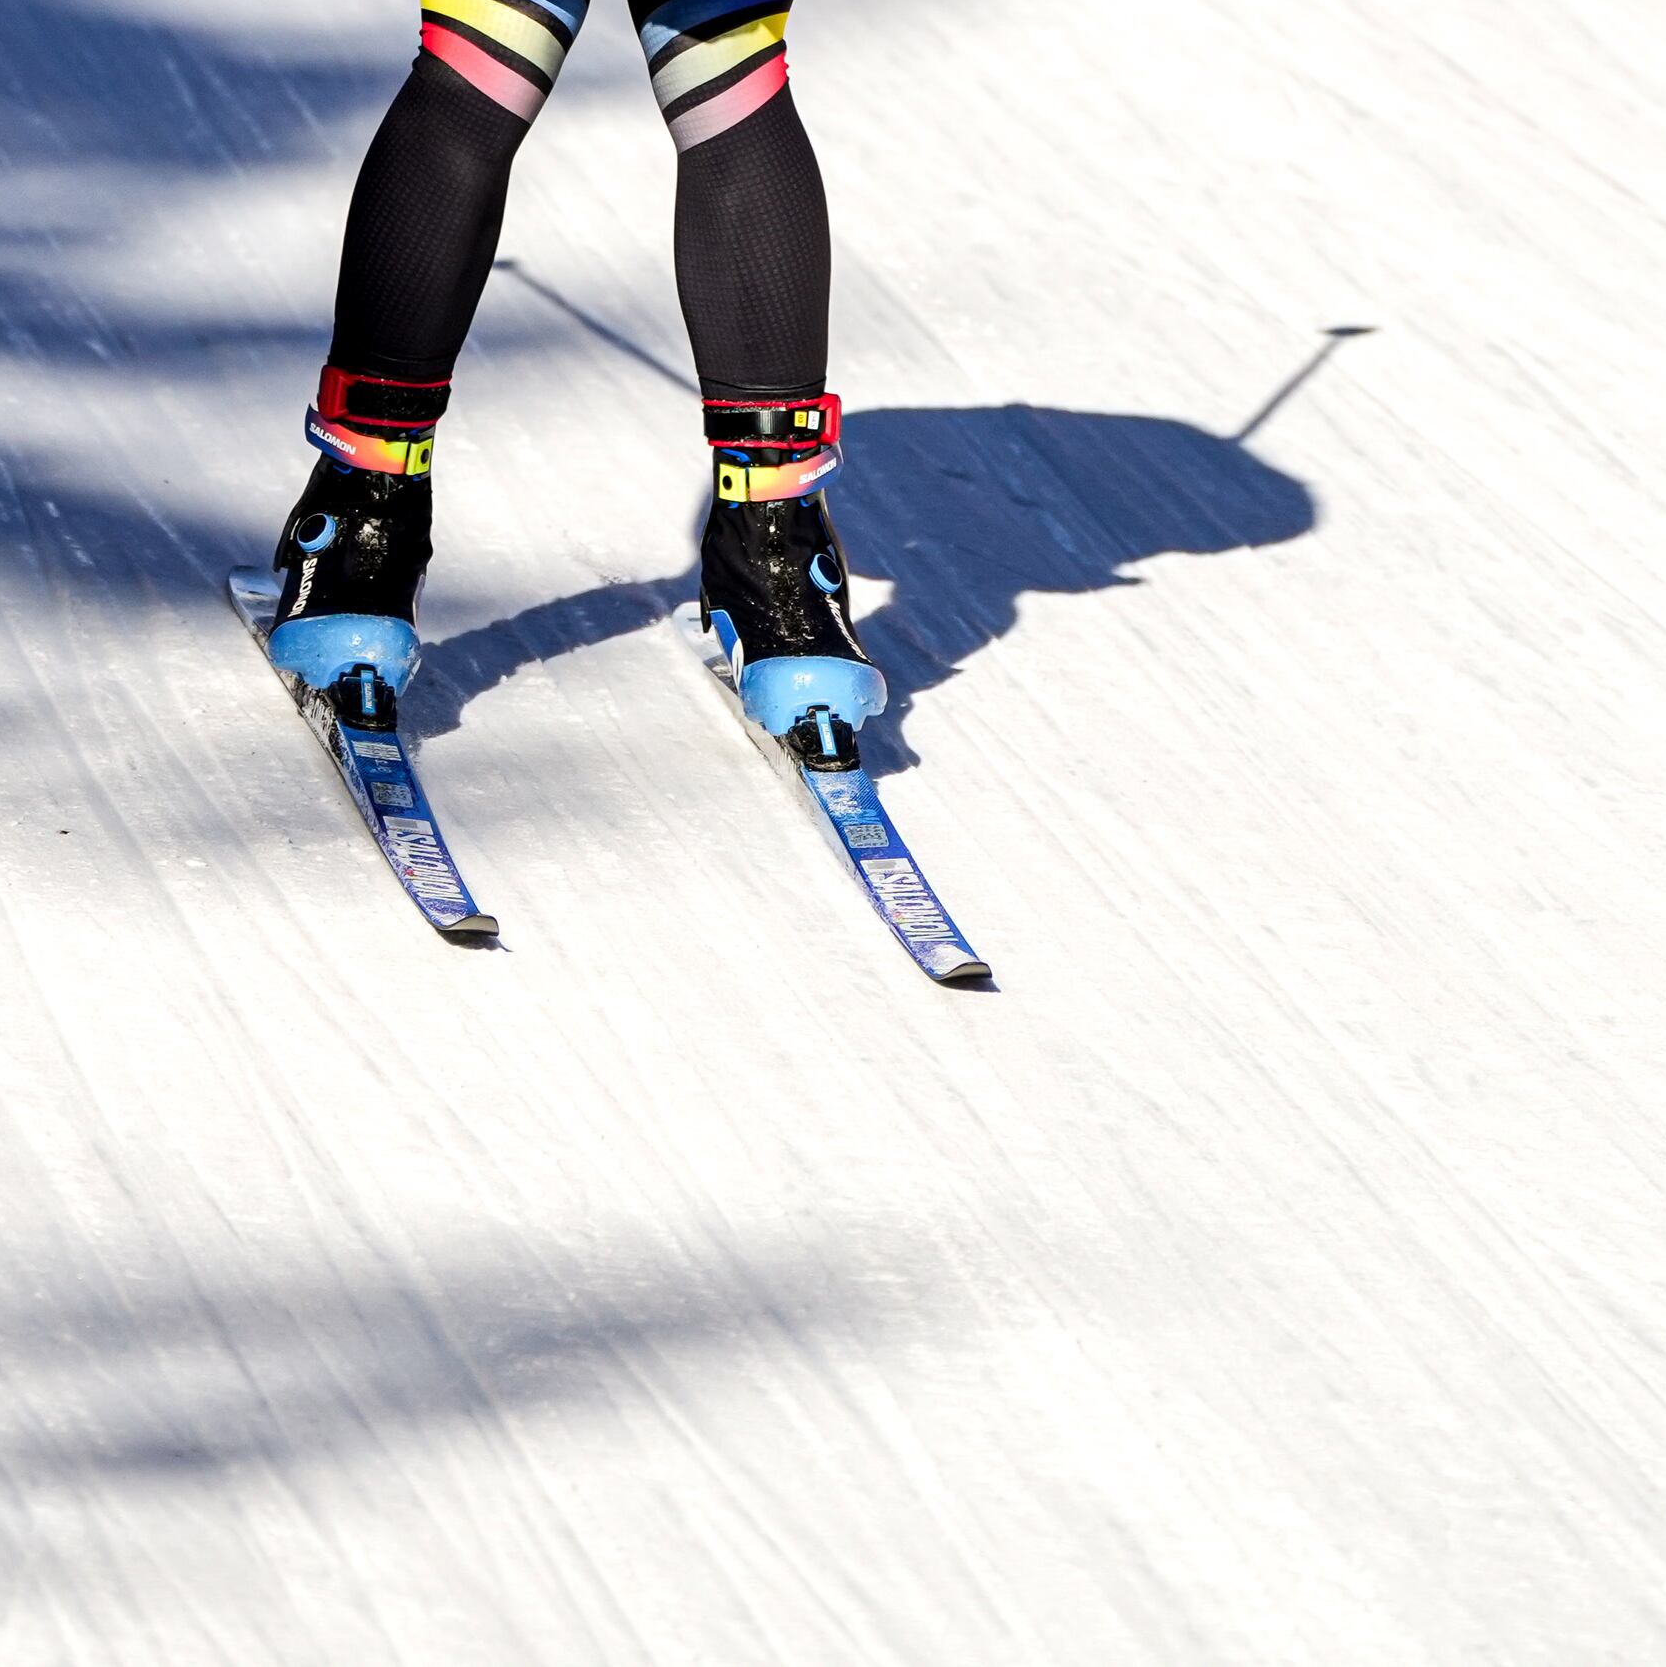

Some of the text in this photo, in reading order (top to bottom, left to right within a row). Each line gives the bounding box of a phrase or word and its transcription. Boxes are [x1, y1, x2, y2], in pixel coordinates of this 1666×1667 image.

[309, 421, 357, 456] SALOMON
[798, 457, 837, 485] SALOMON
[388, 830, 467, 904] SALOMON
[865, 870, 960, 942] SALOMON
